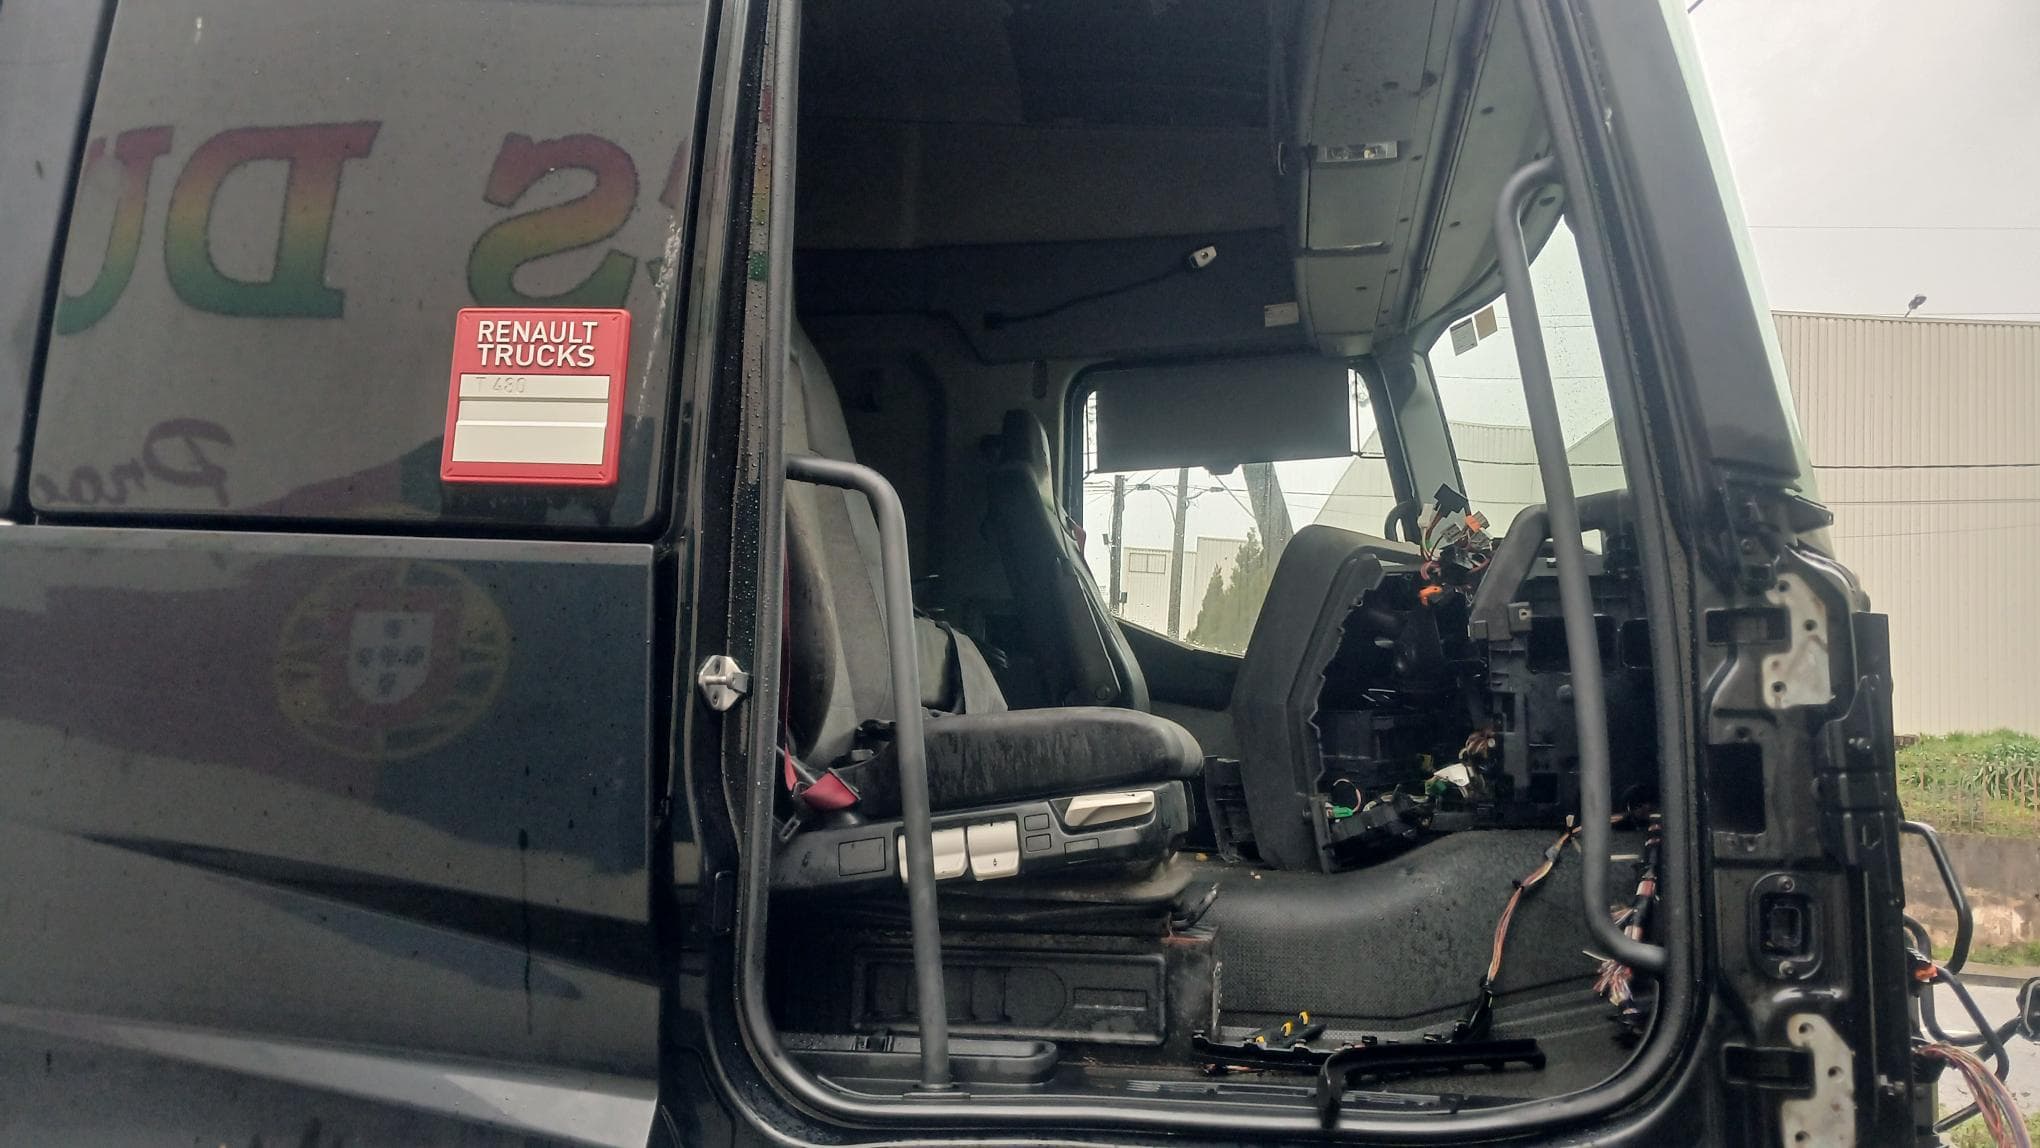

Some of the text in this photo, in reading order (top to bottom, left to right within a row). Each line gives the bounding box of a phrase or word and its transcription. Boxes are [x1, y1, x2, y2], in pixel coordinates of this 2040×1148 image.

[478, 320, 598, 344] RENAULT
[476, 343, 597, 368] TRUCKS
[475, 376, 487, 393] T
